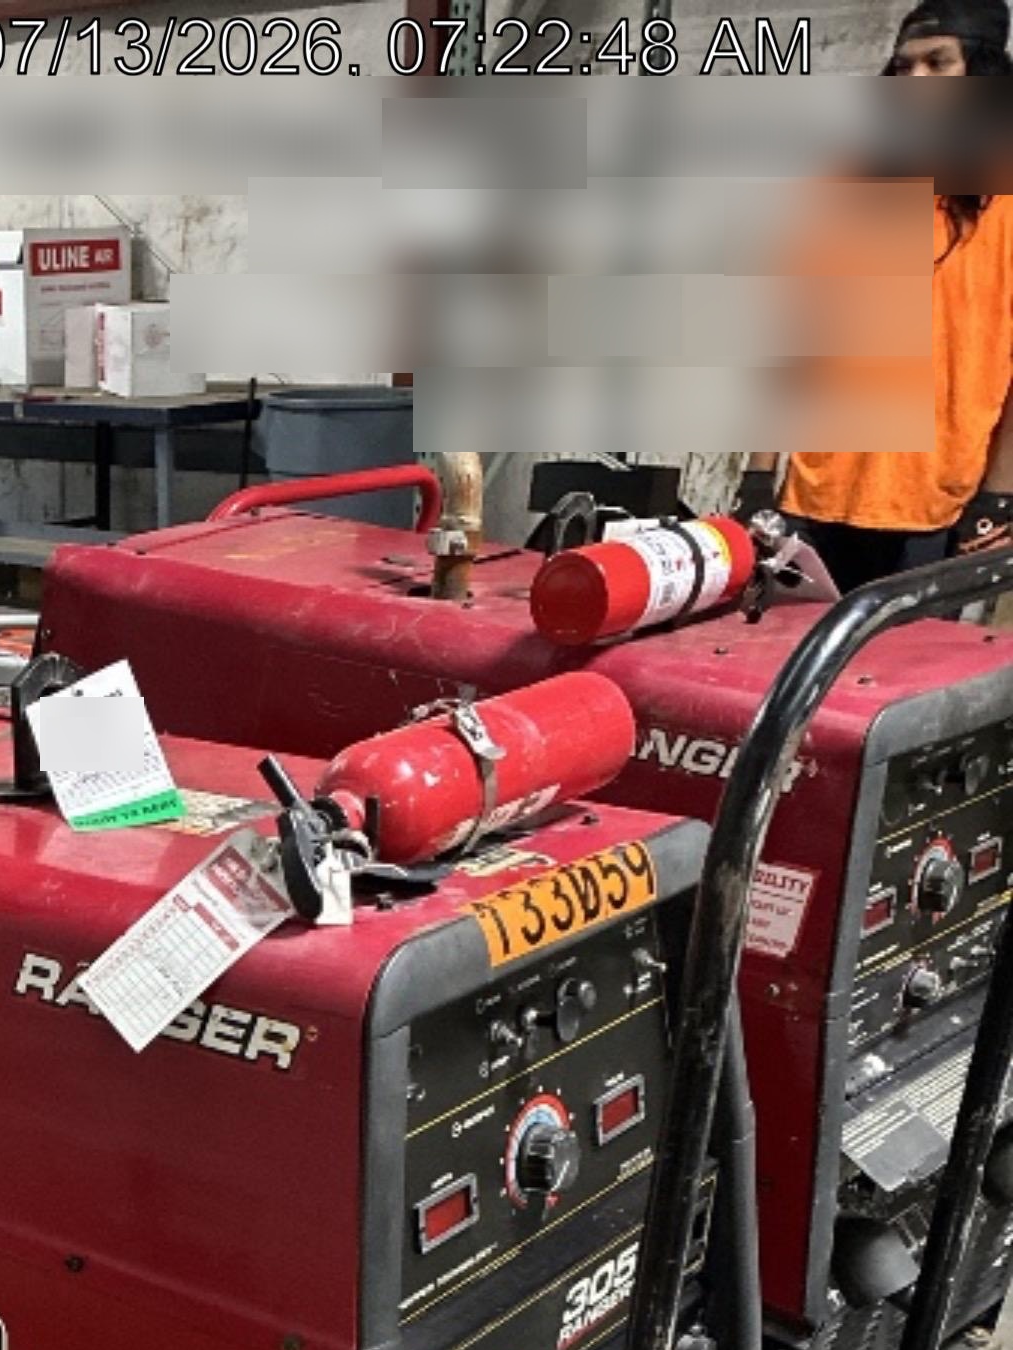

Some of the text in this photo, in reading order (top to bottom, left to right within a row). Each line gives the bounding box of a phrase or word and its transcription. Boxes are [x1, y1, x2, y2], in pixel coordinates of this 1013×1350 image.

[40, 246, 90, 271] ULINE
[14, 953, 301, 1070] RAGER
[563, 1241, 639, 1324] 305
